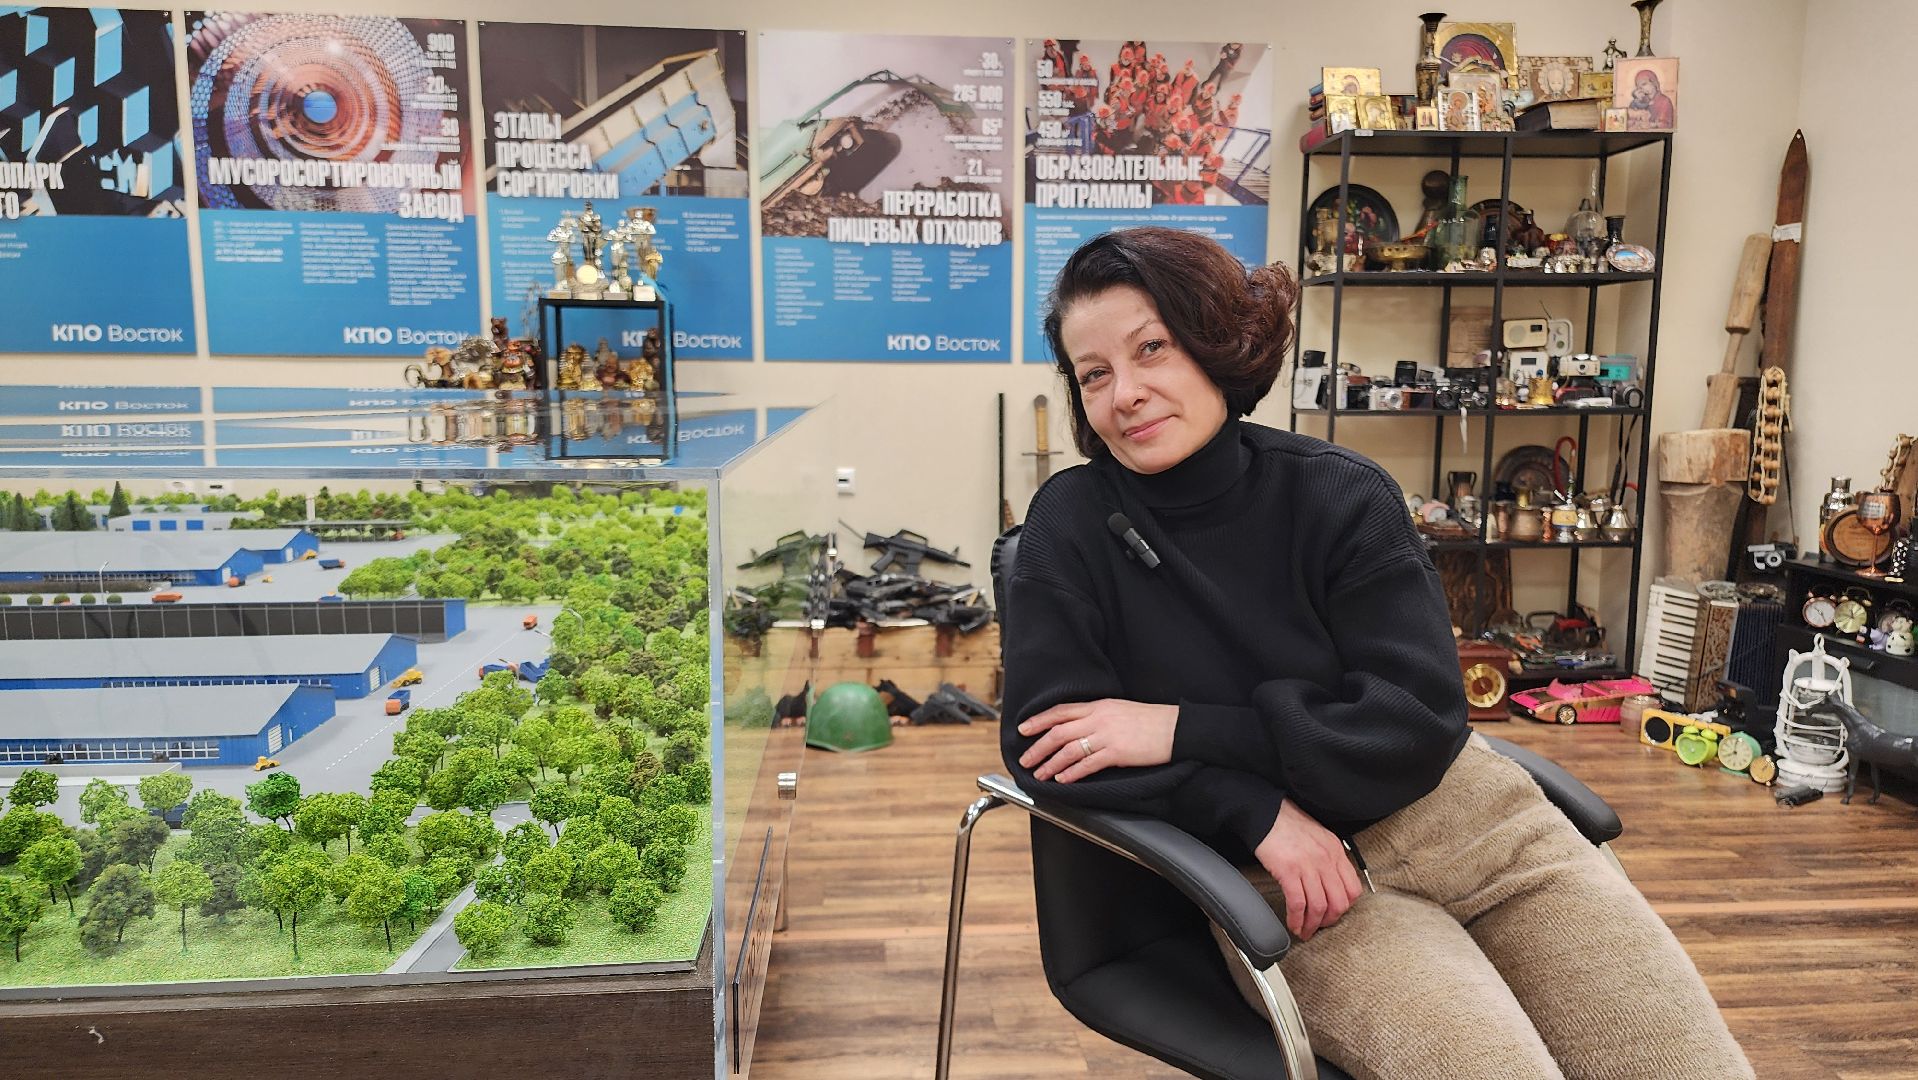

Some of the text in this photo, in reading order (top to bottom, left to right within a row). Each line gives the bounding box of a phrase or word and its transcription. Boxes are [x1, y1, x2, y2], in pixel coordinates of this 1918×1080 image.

[1037, 60, 1053, 78] 50
[494, 112, 562, 139] ЭТАПЫ
[495, 142, 593, 170] ПРОЦЕССА
[1035, 154, 1204, 182] ОБРАЗОВАТЕЛЬНЫЕ
[208, 157, 462, 190] МУСОРОСОРТИРОВОЧНЫЙ
[497, 171, 620, 199] СОРТИРОВКИ
[400, 192, 465, 223] ЗАВОД
[883, 190, 1003, 217] ПЕРЕРАБОТКА
[1035, 183, 1153, 209] ПРОГРАММЫ
[828, 217, 1003, 248] ПИЩЕВЫХ ОТХОДОВ
[52, 324, 184, 343] КПО Восток
[343, 326, 393, 344] КПО
[673, 331, 742, 348] Восток
[887, 335, 1001, 352] КПО Восток
[59, 401, 109, 410] КПО
